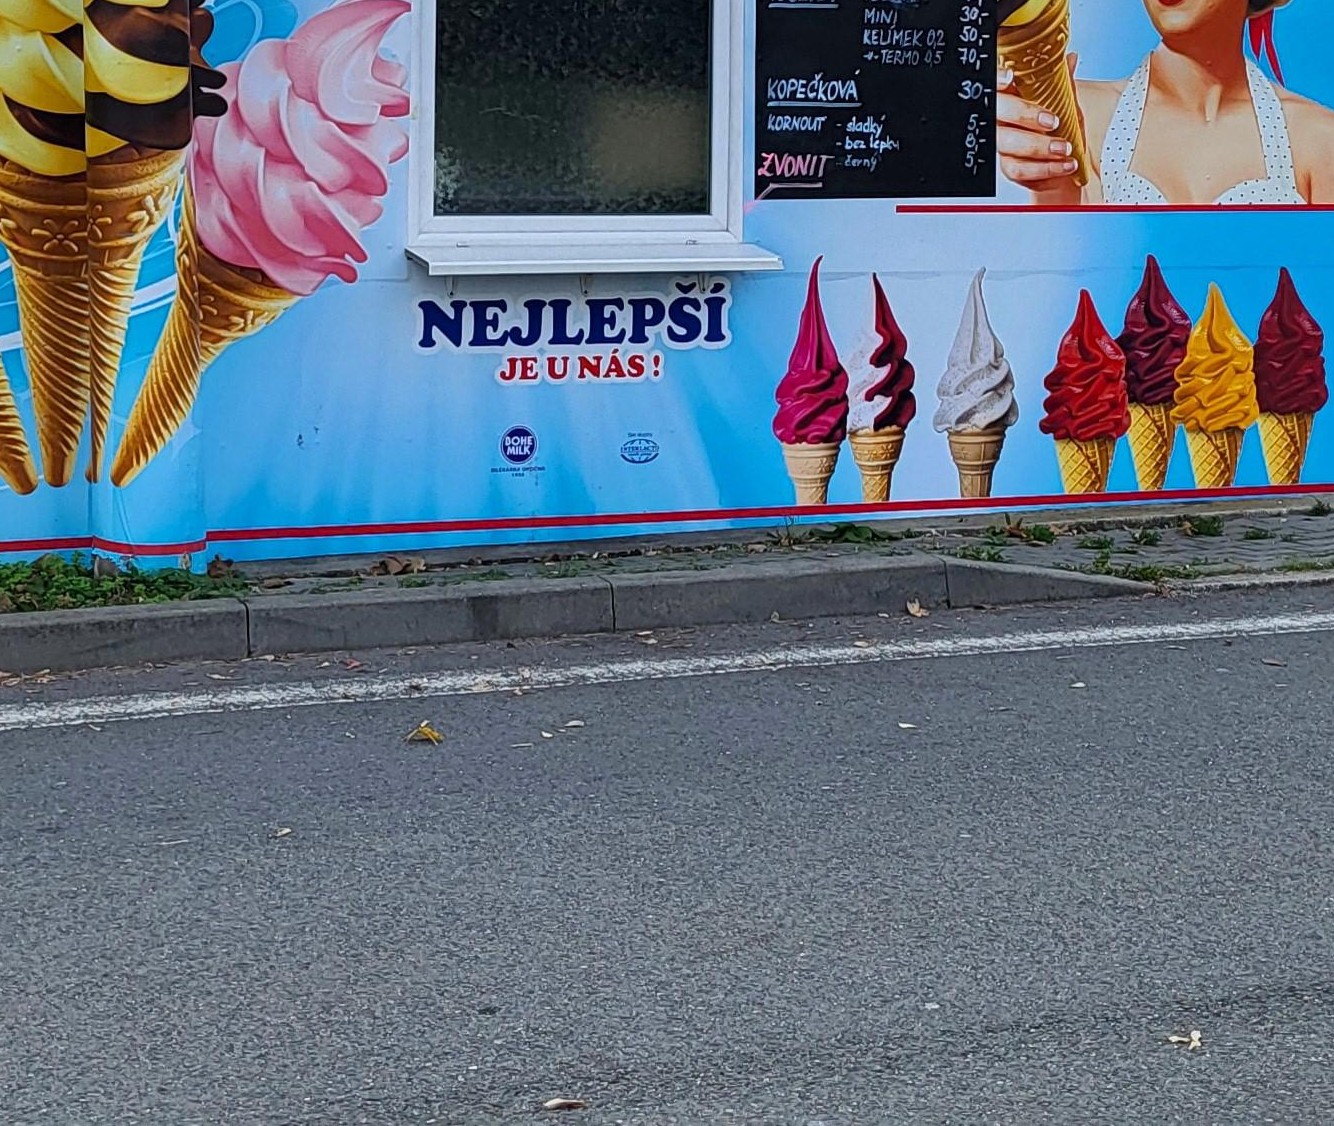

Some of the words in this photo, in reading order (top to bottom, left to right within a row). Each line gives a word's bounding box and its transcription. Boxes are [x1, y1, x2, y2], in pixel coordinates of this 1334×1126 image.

[864, 9, 898, 25] MINI
[863, 26, 923, 47] KELÍMEK
[880, 50, 920, 64] TERMO
[767, 69, 861, 101] KOPEČKOVÁ
[767, 115, 827, 131] KORNOUT
[845, 114, 886, 138] sladký
[844, 136, 866, 150] bez
[758, 152, 834, 178] ZVONIT
[417, 281, 727, 348] NEJLEPŠÍ
[499, 357, 539, 381] JE
[547, 356, 570, 380] U
[505, 435, 533, 446] BOHE
[506, 445, 531, 456] MILK
